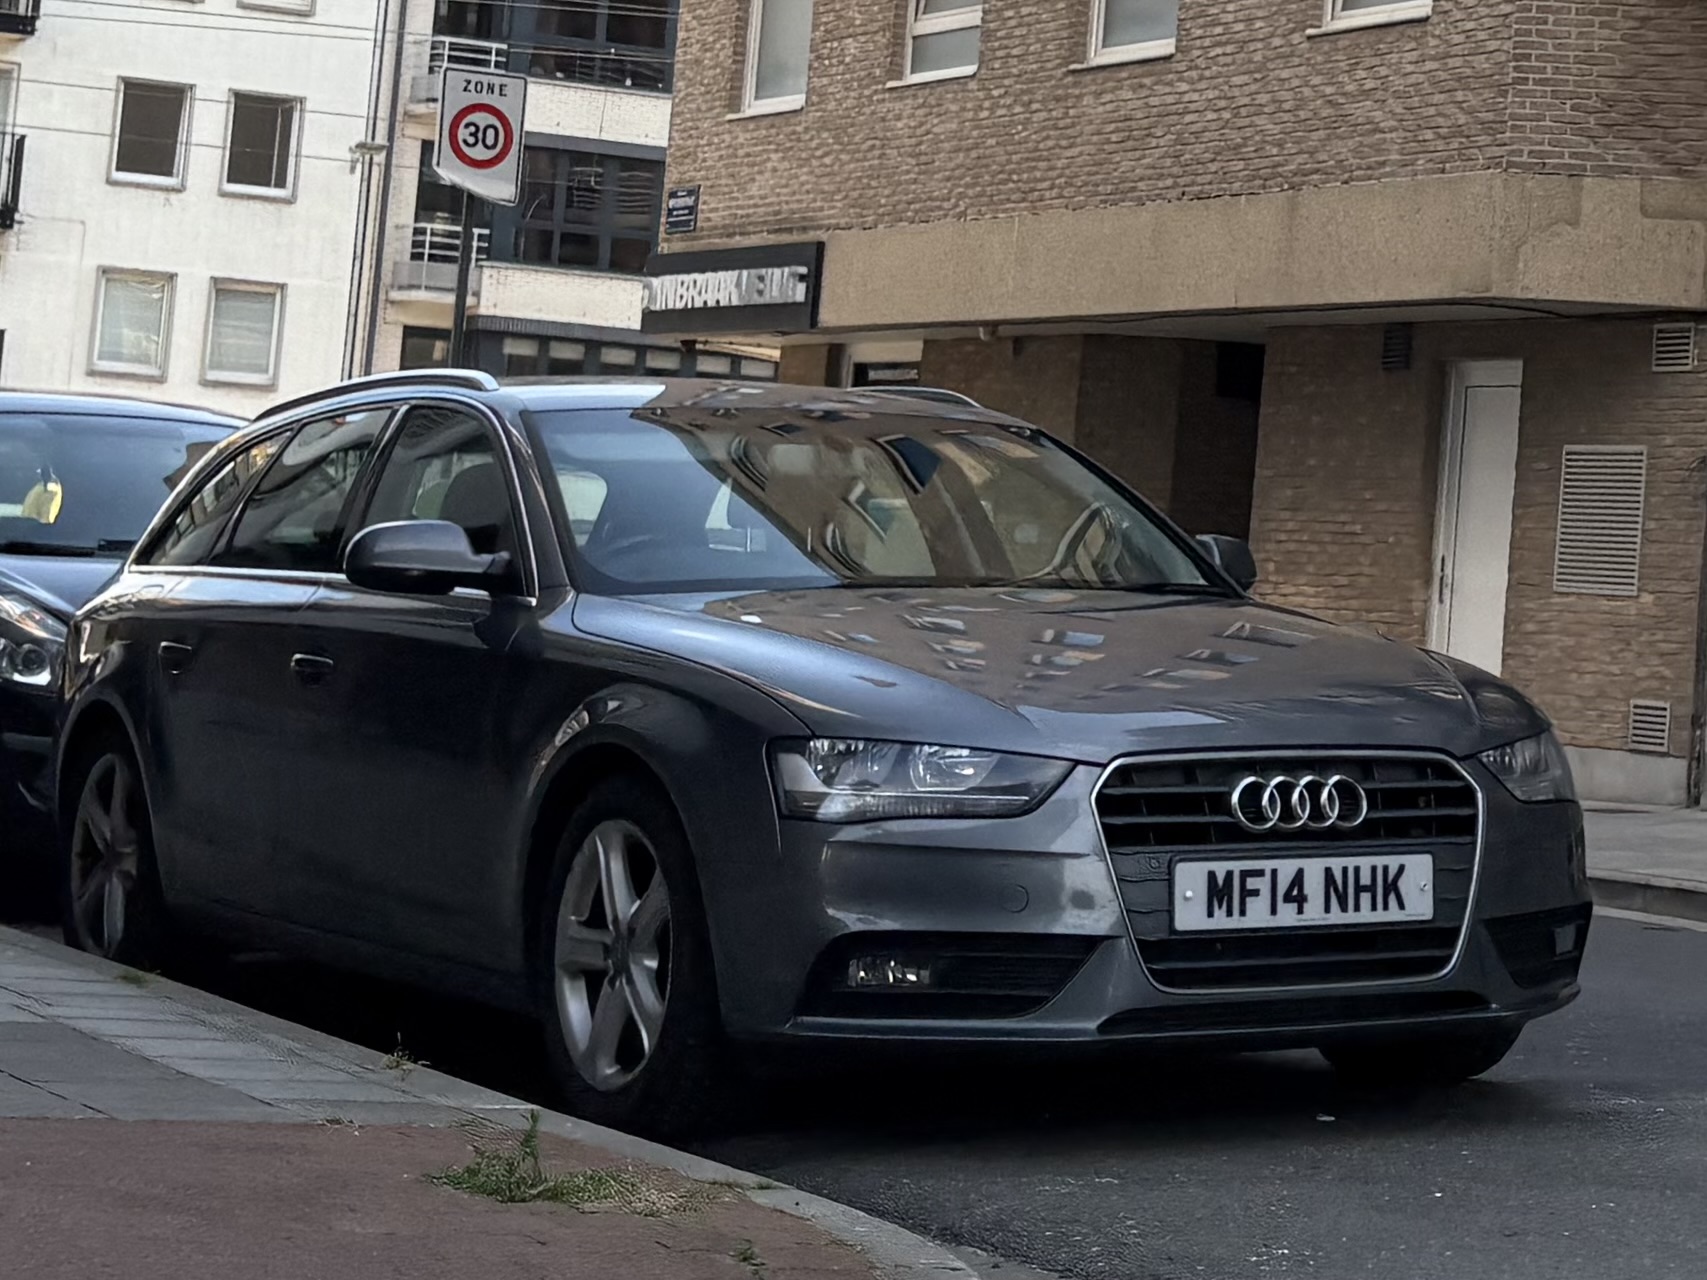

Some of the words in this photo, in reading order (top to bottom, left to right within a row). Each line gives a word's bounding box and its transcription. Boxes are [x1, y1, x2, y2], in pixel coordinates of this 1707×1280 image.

[462, 79, 508, 97] ZONE
[462, 121, 500, 150] 30
[1206, 867, 1309, 919] MF14
[1323, 863, 1406, 915] NHK
